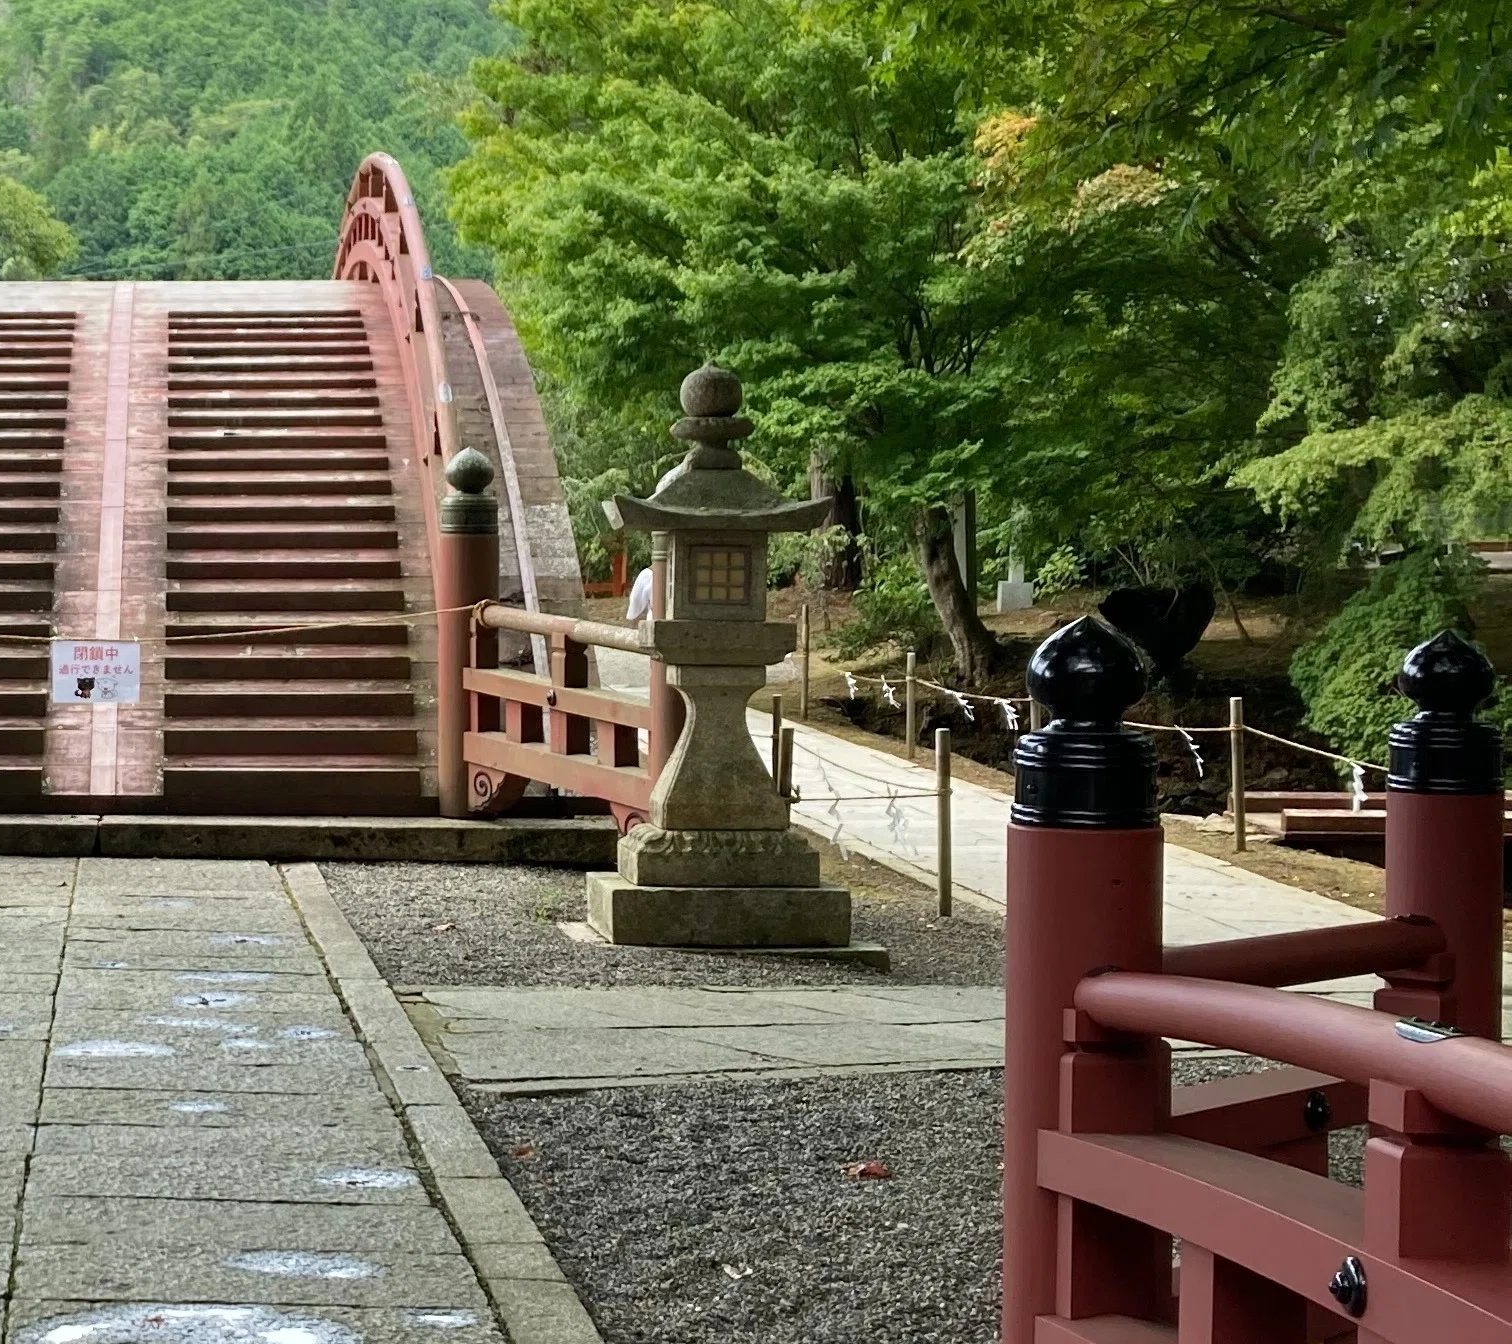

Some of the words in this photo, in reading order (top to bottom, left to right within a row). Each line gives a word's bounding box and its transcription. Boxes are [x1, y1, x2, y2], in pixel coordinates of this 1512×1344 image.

[73, 646, 119, 661] 閉鎖中
[58, 664, 134, 675] 通行できません
